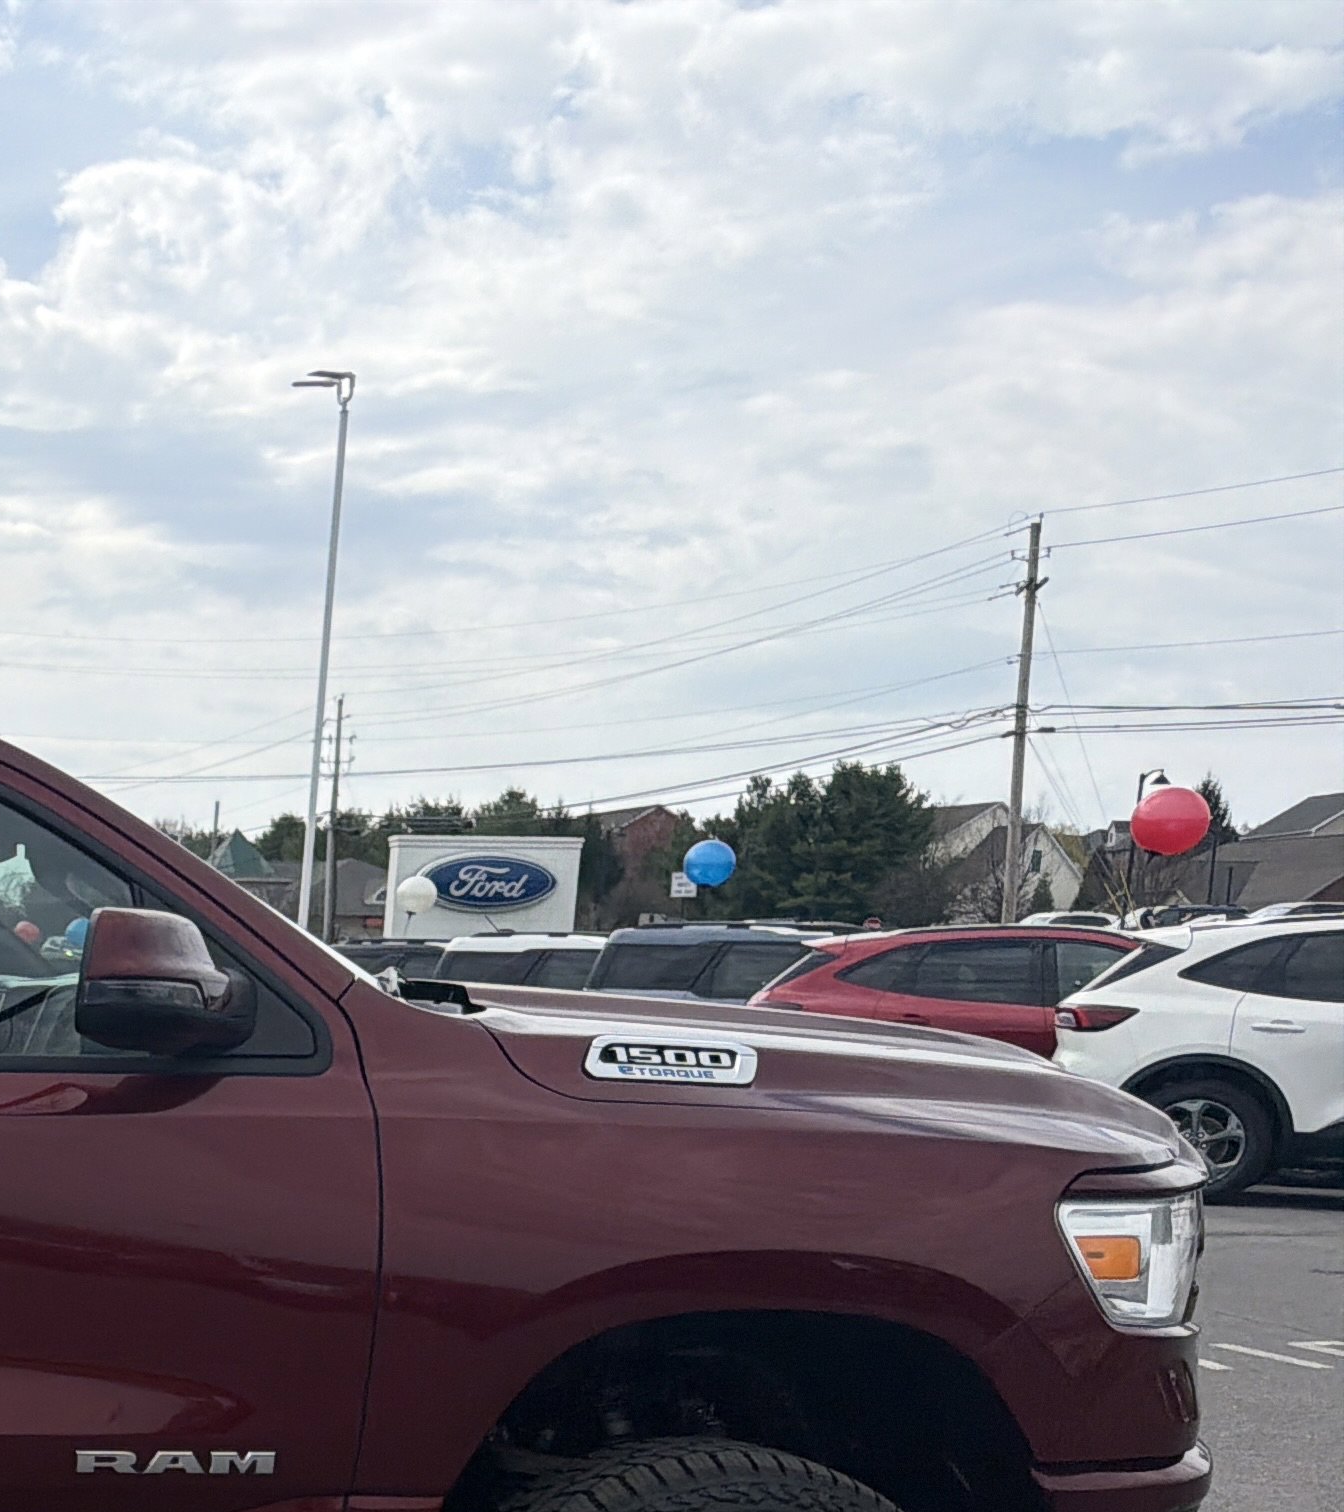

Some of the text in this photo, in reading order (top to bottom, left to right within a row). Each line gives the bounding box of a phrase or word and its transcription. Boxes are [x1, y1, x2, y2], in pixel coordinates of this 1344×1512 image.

[449, 864, 529, 898] Ford
[609, 1046, 732, 1067] 1500
[75, 1450, 276, 1475] RAM
